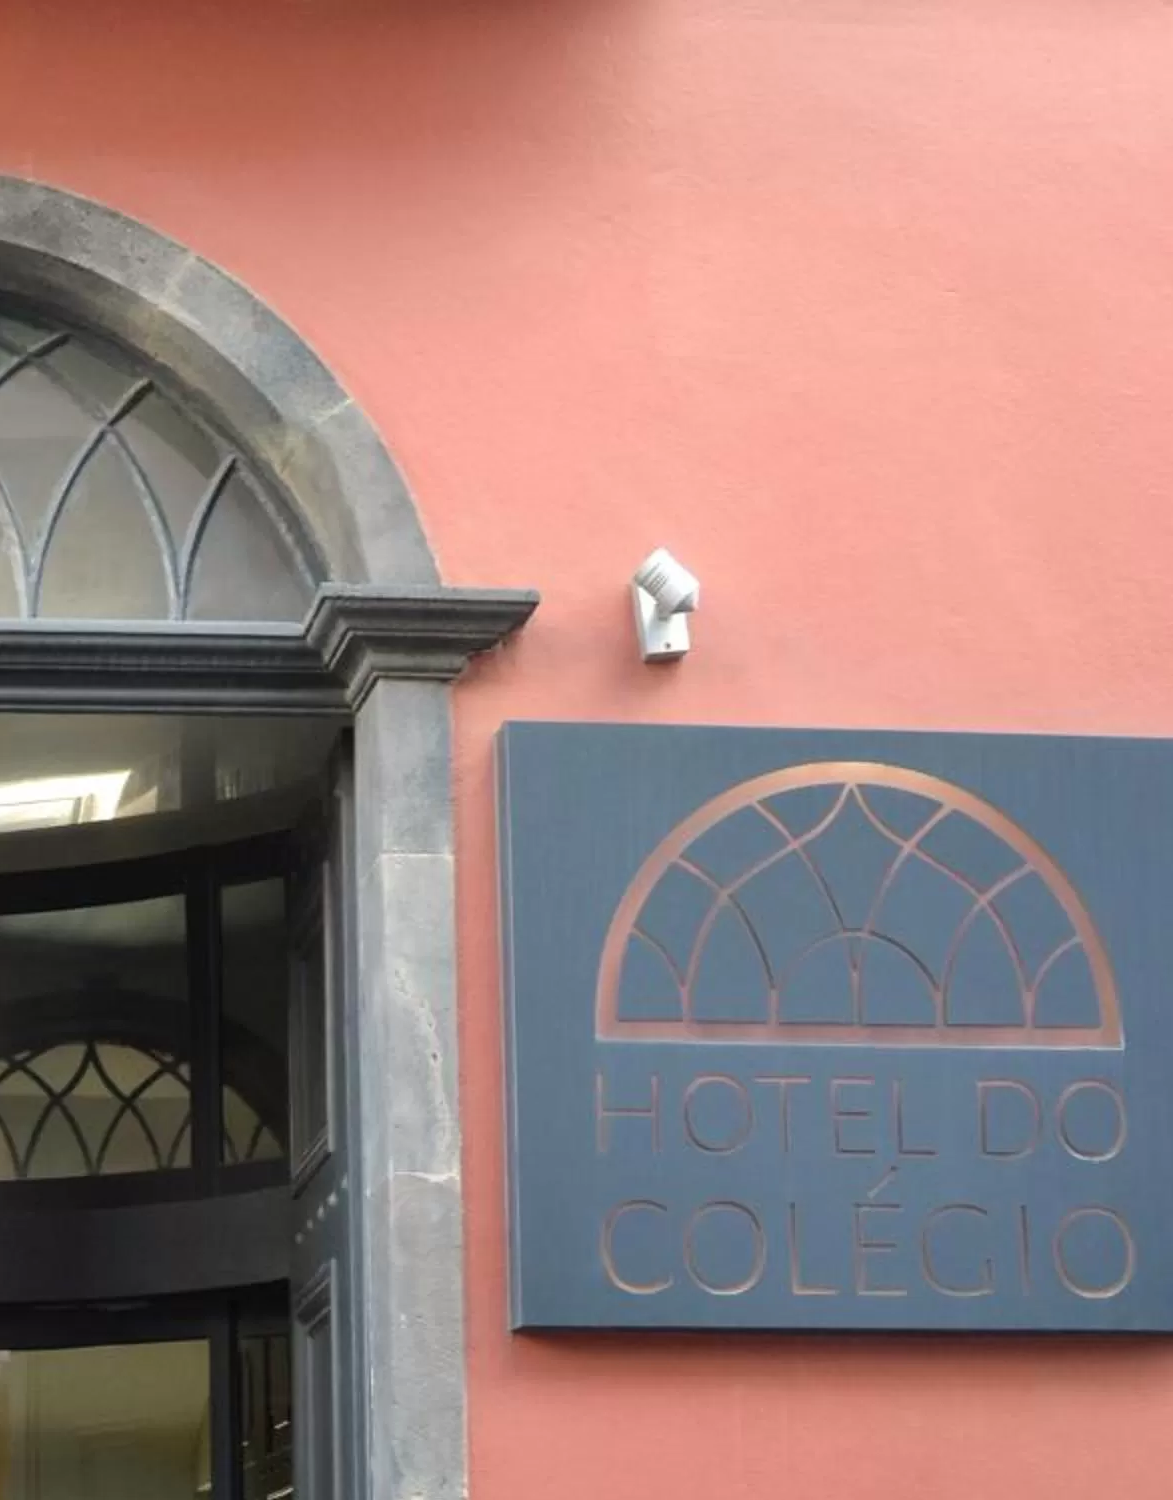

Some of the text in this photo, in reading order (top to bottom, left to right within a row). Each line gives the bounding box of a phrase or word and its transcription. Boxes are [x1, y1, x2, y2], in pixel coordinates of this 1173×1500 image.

[594, 1072, 1128, 1162] HOTEL DO
[600, 1165, 1135, 1298] COLÉGIO
